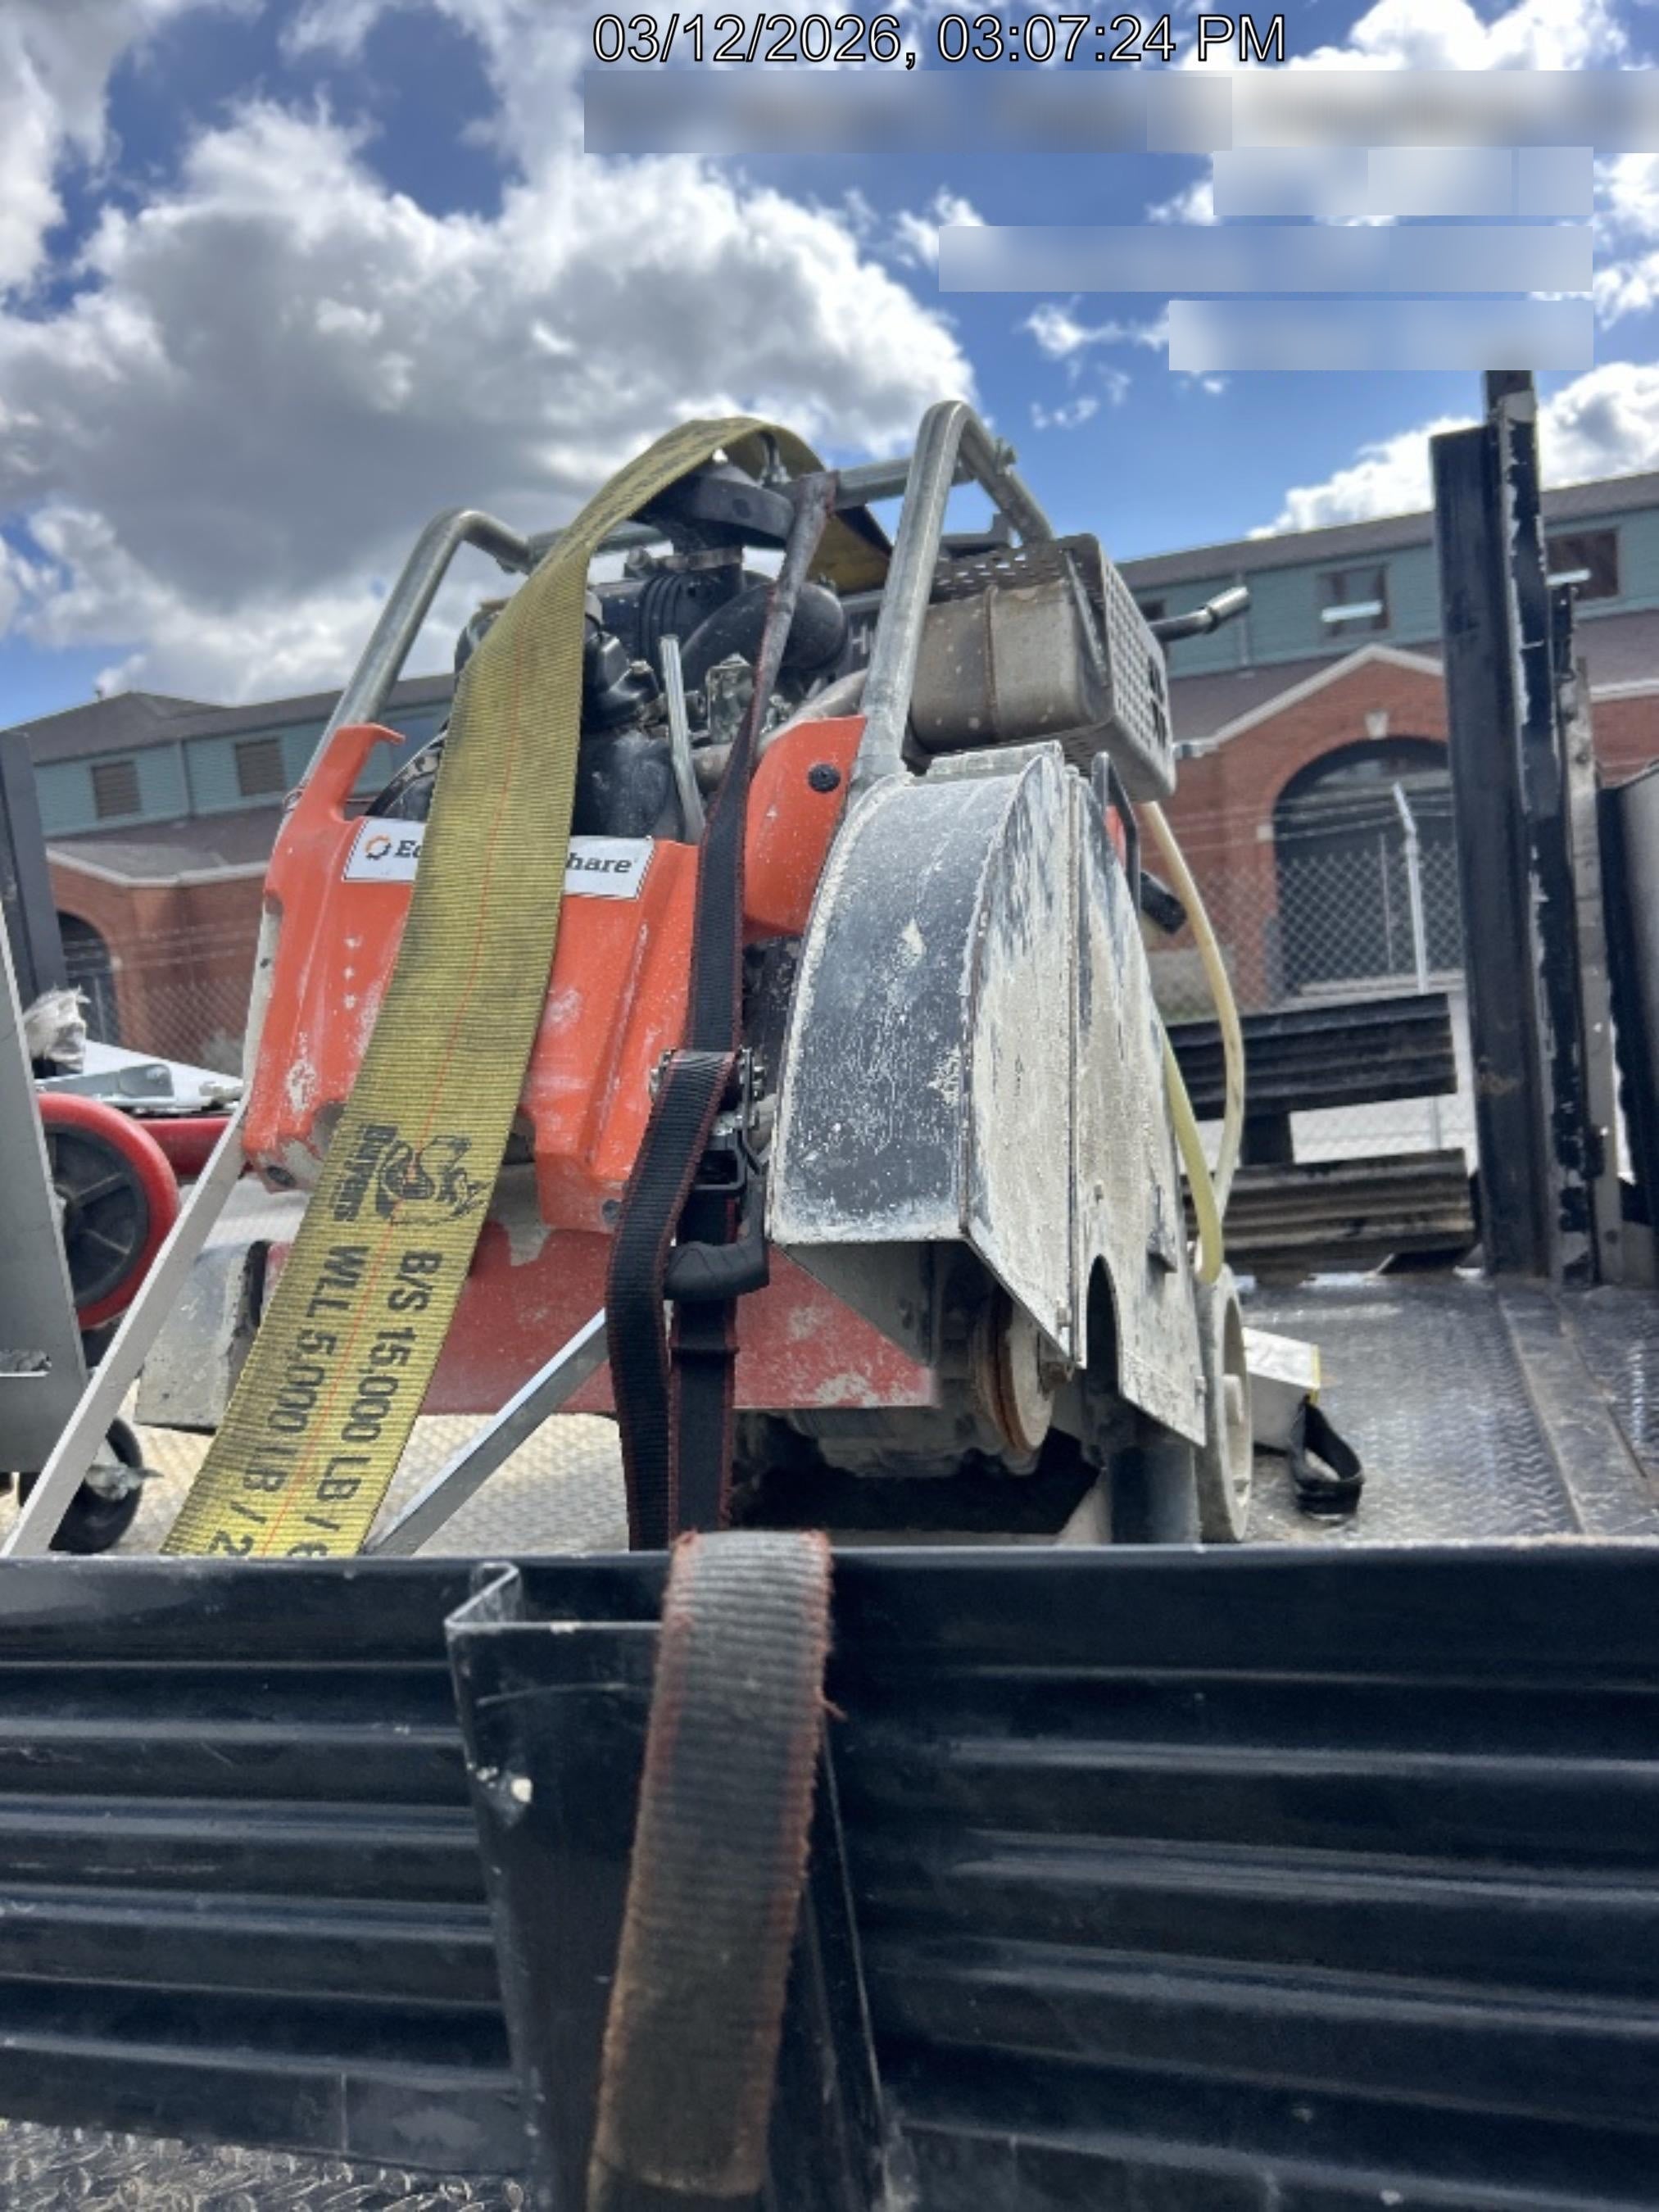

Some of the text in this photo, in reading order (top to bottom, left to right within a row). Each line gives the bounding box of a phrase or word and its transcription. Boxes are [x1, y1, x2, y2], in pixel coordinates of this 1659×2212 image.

[306, 1245, 371, 1318] WLL
[388, 1249, 443, 1312] B/S
[315, 1456, 371, 1502] LB
